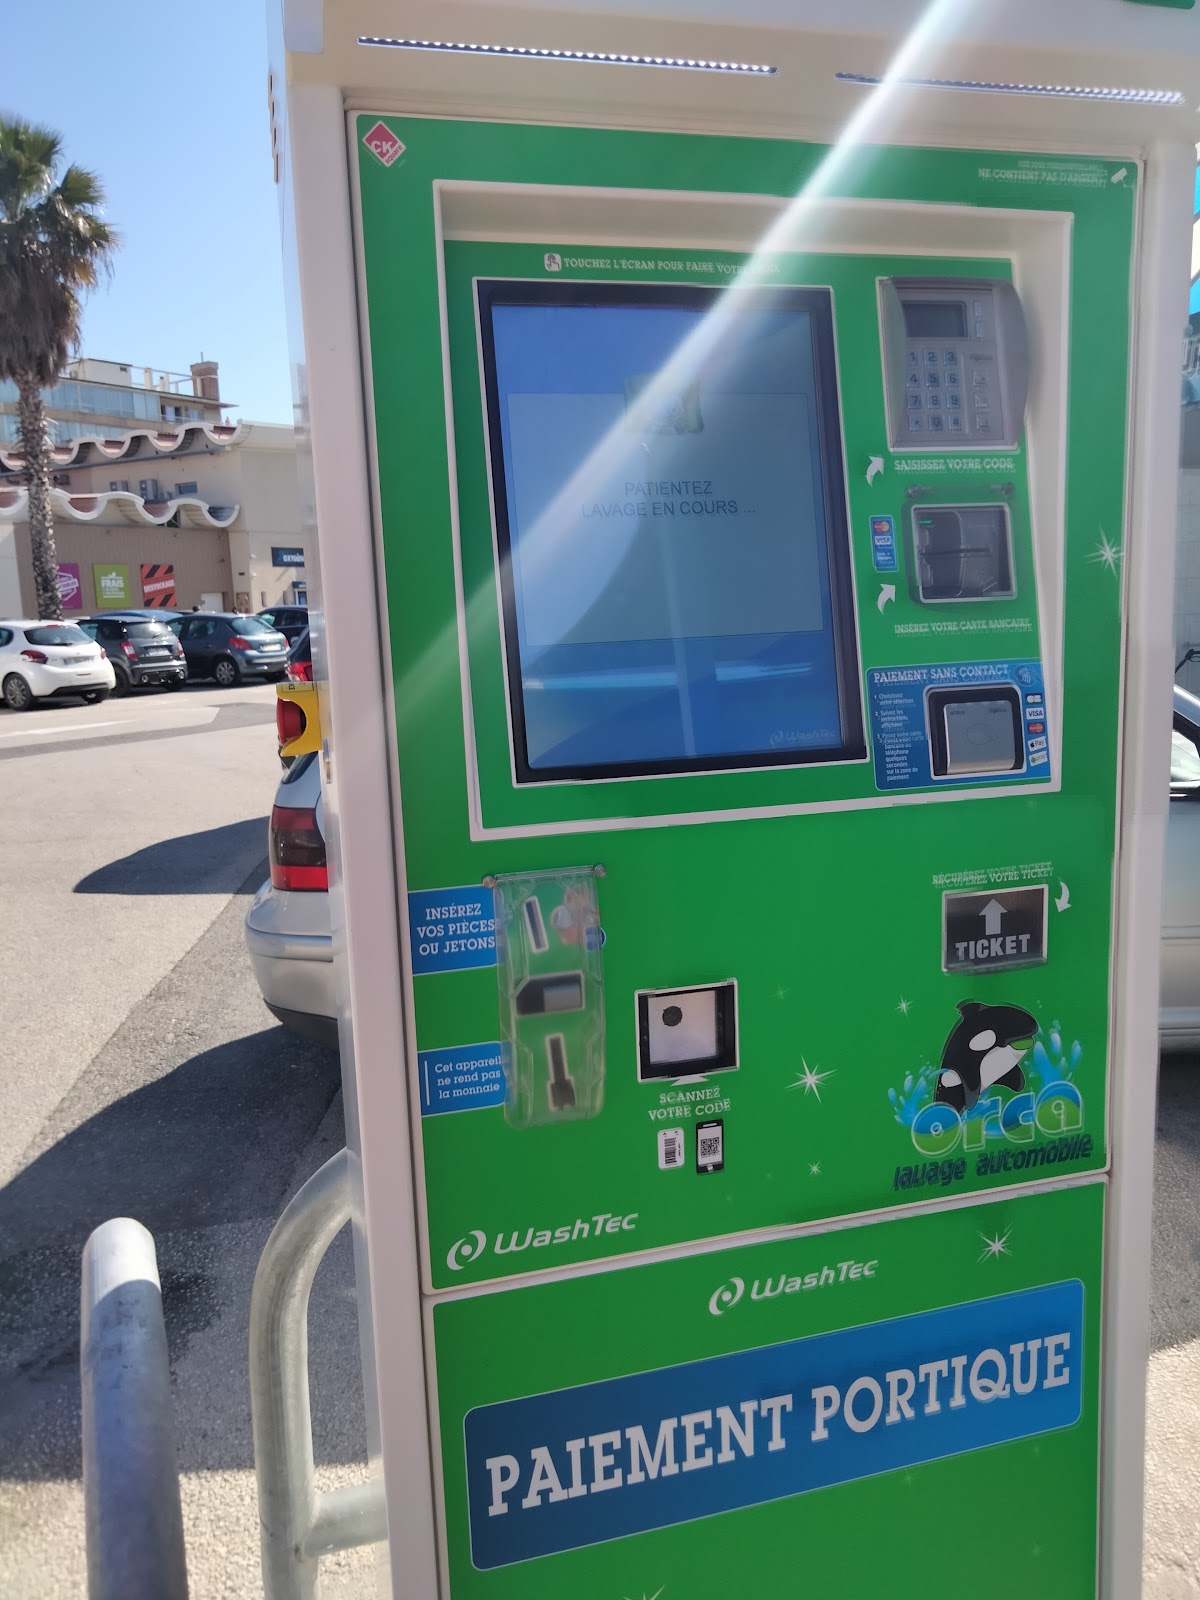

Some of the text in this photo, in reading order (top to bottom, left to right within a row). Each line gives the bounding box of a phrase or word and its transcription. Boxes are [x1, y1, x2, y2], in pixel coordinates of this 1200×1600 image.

[370, 140, 393, 153] CK
[564, 257, 611, 268] TOUCHEZ
[613, 256, 655, 270] L'ÉCRAN
[657, 260, 684, 271] POUR
[686, 260, 716, 273] FAIRE
[716, 262, 751, 274] VOTR
[927, 352, 936, 361] 2
[947, 352, 955, 361] 3
[909, 373, 957, 384] 4 5 6
[911, 395, 958, 406] 7 8 9
[894, 458, 1015, 471] SAISISSEZ VOTRE CODE
[624, 481, 713, 496] PATIENTEZ
[581, 502, 648, 518] LAVAGE
[652, 501, 675, 516] EN
[679, 500, 738, 515] COURS
[283, 553, 305, 562] OXYGÈN
[101, 580, 124, 588] FRAIS
[894, 618, 1032, 635] INSÉREZ VOTRE CARTE BANCAIRE
[873, 664, 1010, 684] PAIEMENT SANS CONTACT
[932, 863, 1055, 888] RÉCUPÉREZ VOTRE TICKET
[425, 902, 482, 921] INSÉREZ
[416, 917, 495, 939] VOS PIÈCES
[418, 935, 496, 956] OU JETONS
[955, 933, 1031, 961] TICKET
[434, 1054, 503, 1074] Cet appareil
[437, 1068, 501, 1087] ne rend pas
[438, 1081, 500, 1099] la monnaie
[659, 1085, 721, 1104] SCANNEZ
[648, 1098, 731, 1122] VOTRE CODE
[975, 1133, 1094, 1176] automobile
[494, 1212, 639, 1254] WashTec
[750, 1259, 879, 1301] WashTec
[485, 1331, 1071, 1518] PAIEMENT PORTIQUE
